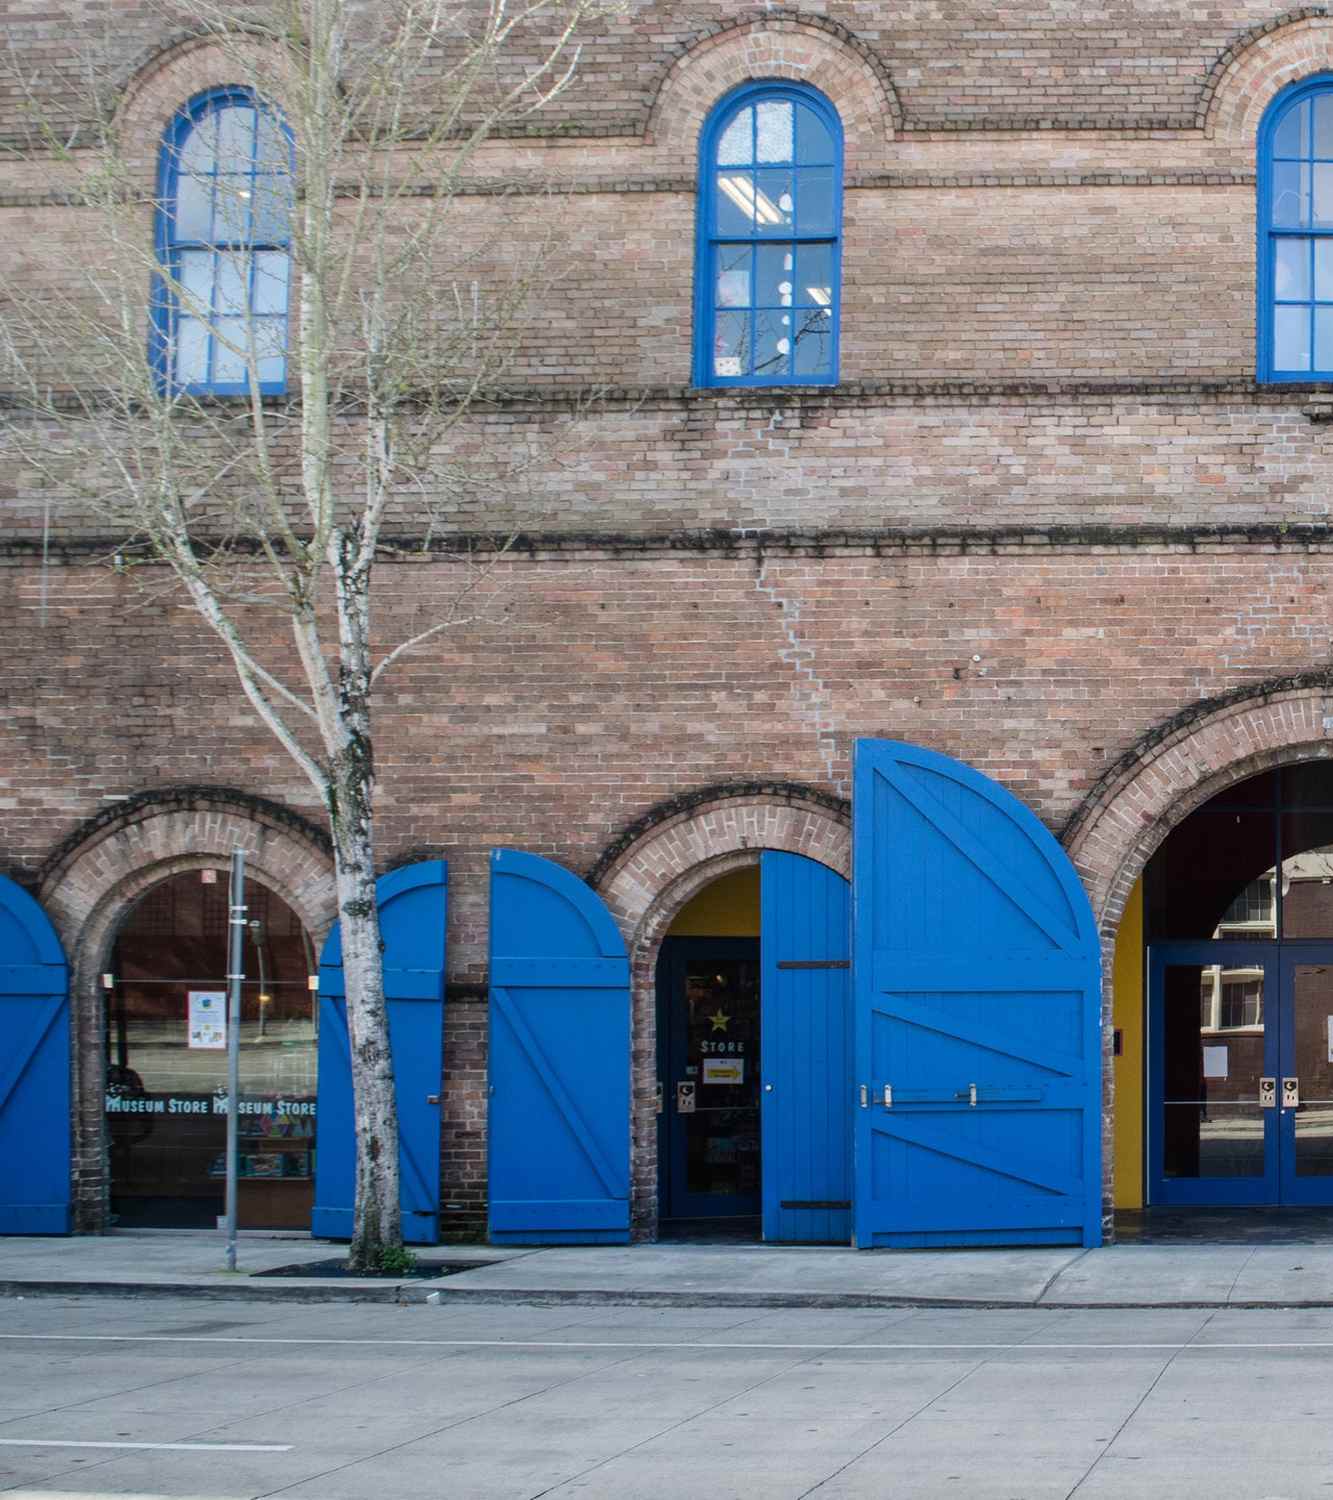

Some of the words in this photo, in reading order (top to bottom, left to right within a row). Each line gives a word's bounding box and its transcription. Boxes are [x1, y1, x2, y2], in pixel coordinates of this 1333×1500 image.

[700, 1040, 745, 1053] STORE
[105, 1094, 165, 1113] MUSEUM
[168, 1098, 209, 1114] STORE
[212, 1096, 273, 1114] MSEUM
[277, 1100, 317, 1116] STORE
